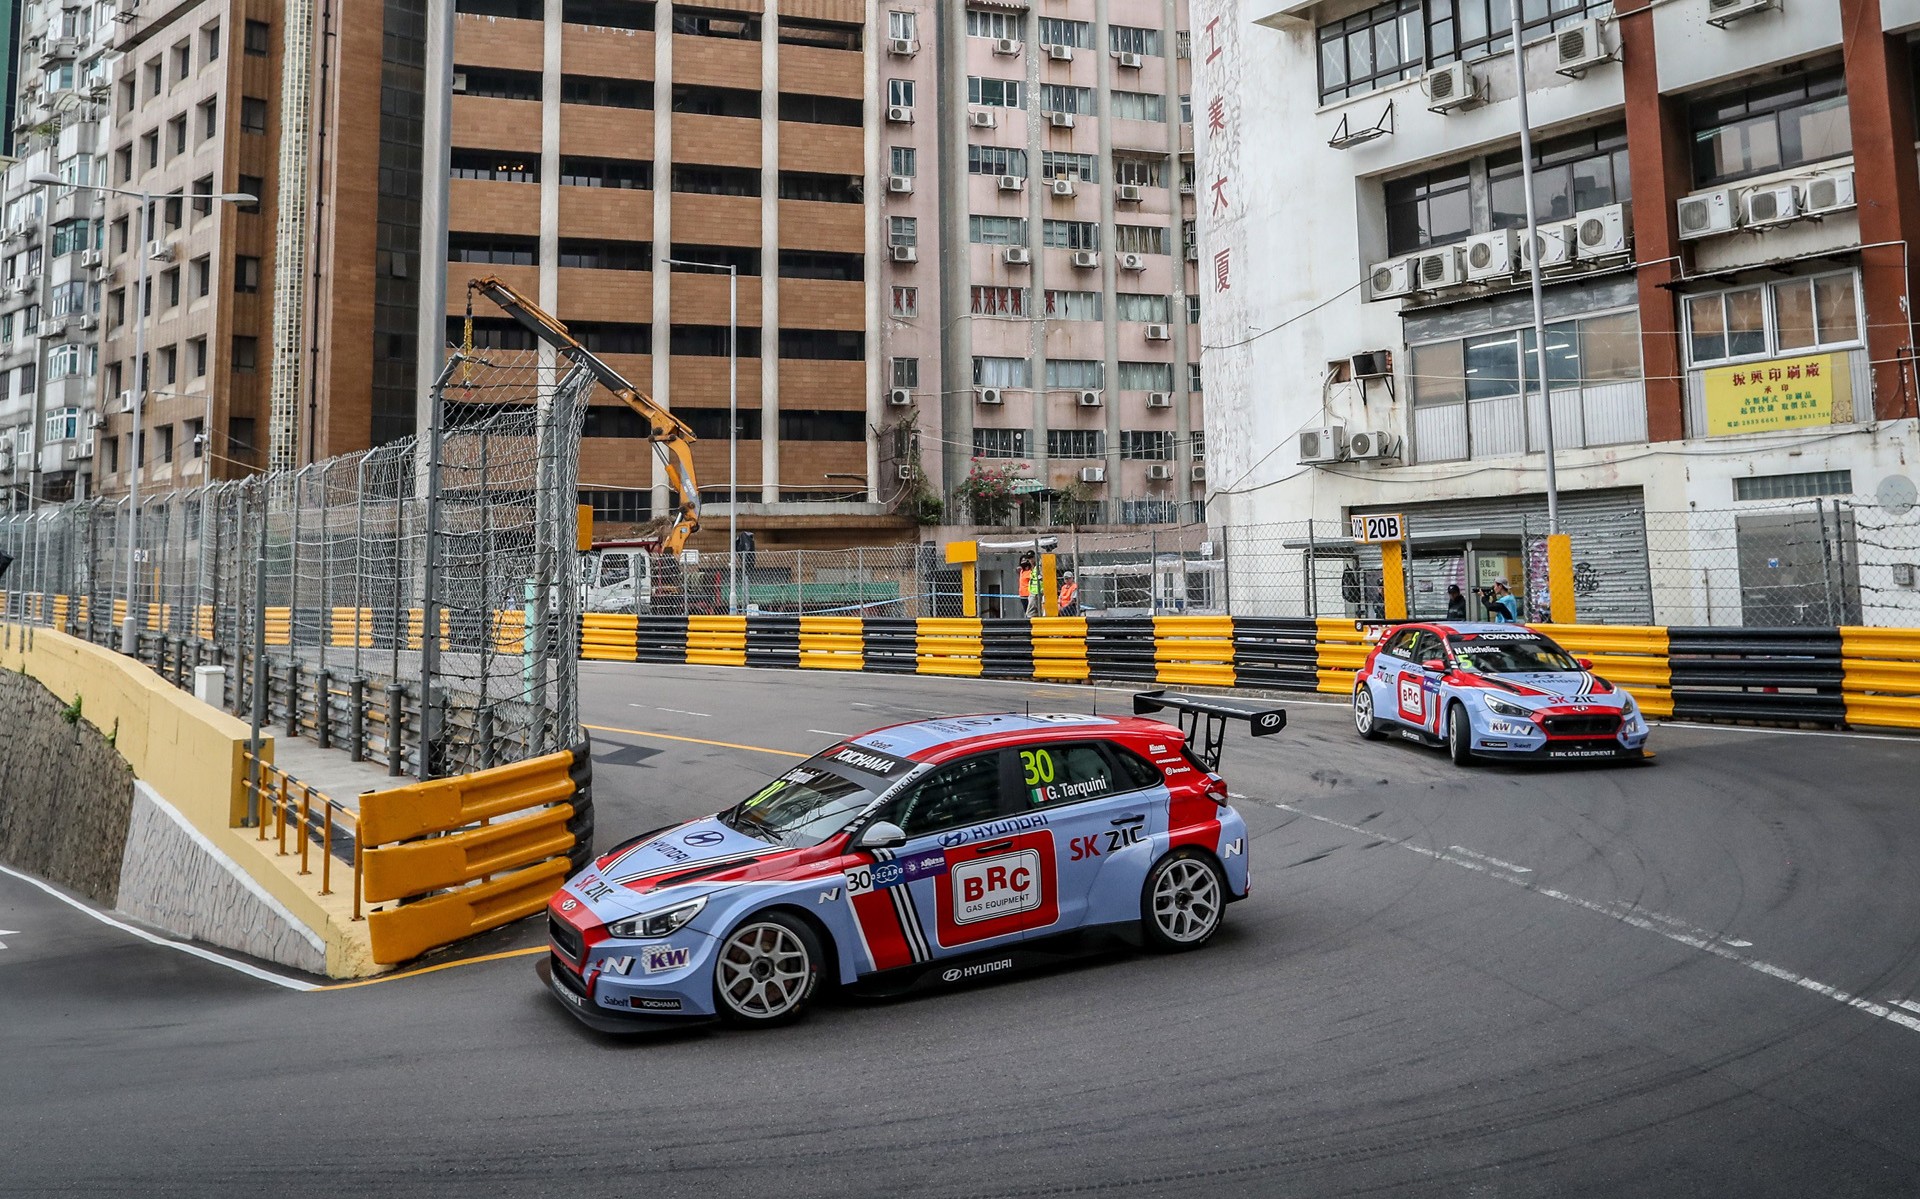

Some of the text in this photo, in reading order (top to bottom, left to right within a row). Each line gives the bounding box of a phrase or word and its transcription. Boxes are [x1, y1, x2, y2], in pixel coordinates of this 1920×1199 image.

[1732, 362, 1820, 387] 振興印刷廠
[1368, 517, 1398, 539] 20B
[1479, 633, 1541, 641] YOKOHAMA
[1457, 654, 1473, 669] 5
[1402, 687, 1420, 706] BRC
[1548, 695, 1600, 704] SK ZIC
[1492, 721, 1511, 732] KW
[834, 748, 896, 773] YOKOHAMA
[1020, 749, 1055, 785] 30
[1047, 775, 1107, 801] G. Tarquini
[971, 814, 1049, 840] HYUNDAI
[649, 841, 691, 863] HYUNDAI
[1070, 824, 1147, 861] SK ZIC
[846, 867, 904, 892] 30 OSCARO
[963, 865, 1031, 903] BRC
[966, 893, 1030, 913] GAS EQUIPMENT
[650, 948, 689, 969] KW
[963, 958, 1013, 977] HYUNDAI
[603, 995, 629, 1007] Sabelt
[641, 999, 680, 1008] YOKOHAMA
